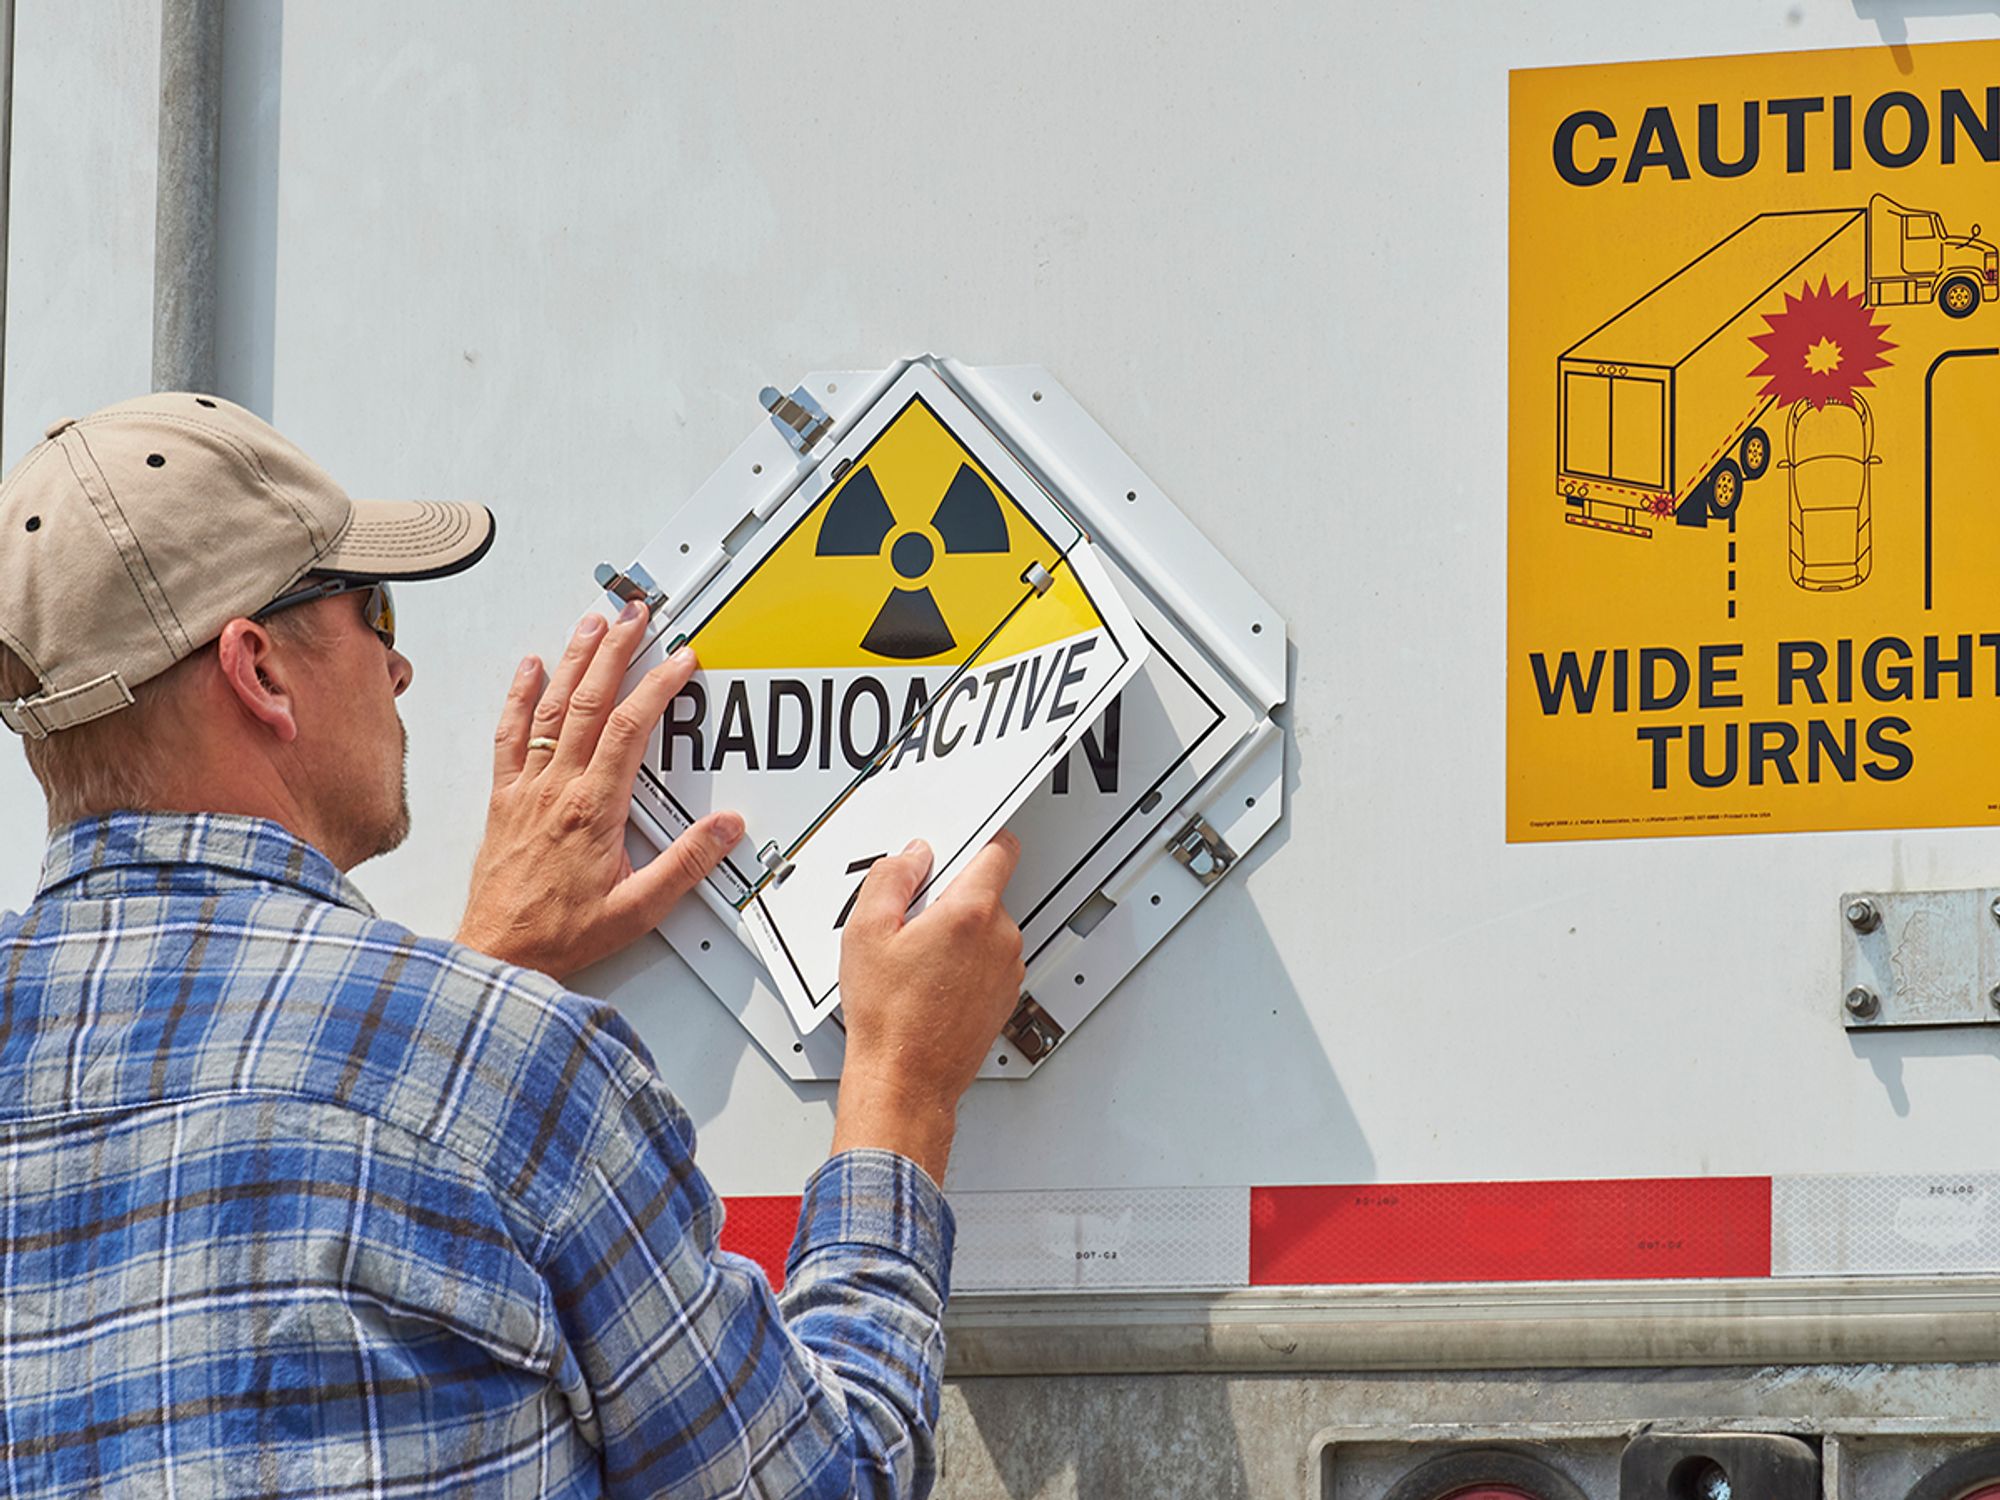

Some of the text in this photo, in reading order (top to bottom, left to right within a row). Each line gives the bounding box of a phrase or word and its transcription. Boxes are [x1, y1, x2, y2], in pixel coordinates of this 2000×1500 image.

[1553, 87, 2000, 186] CAUTION
[660, 637, 1098, 774] RADIOACTIVE
[1529, 643, 1744, 715] WIDE
[1637, 716, 1914, 790] TURNS
